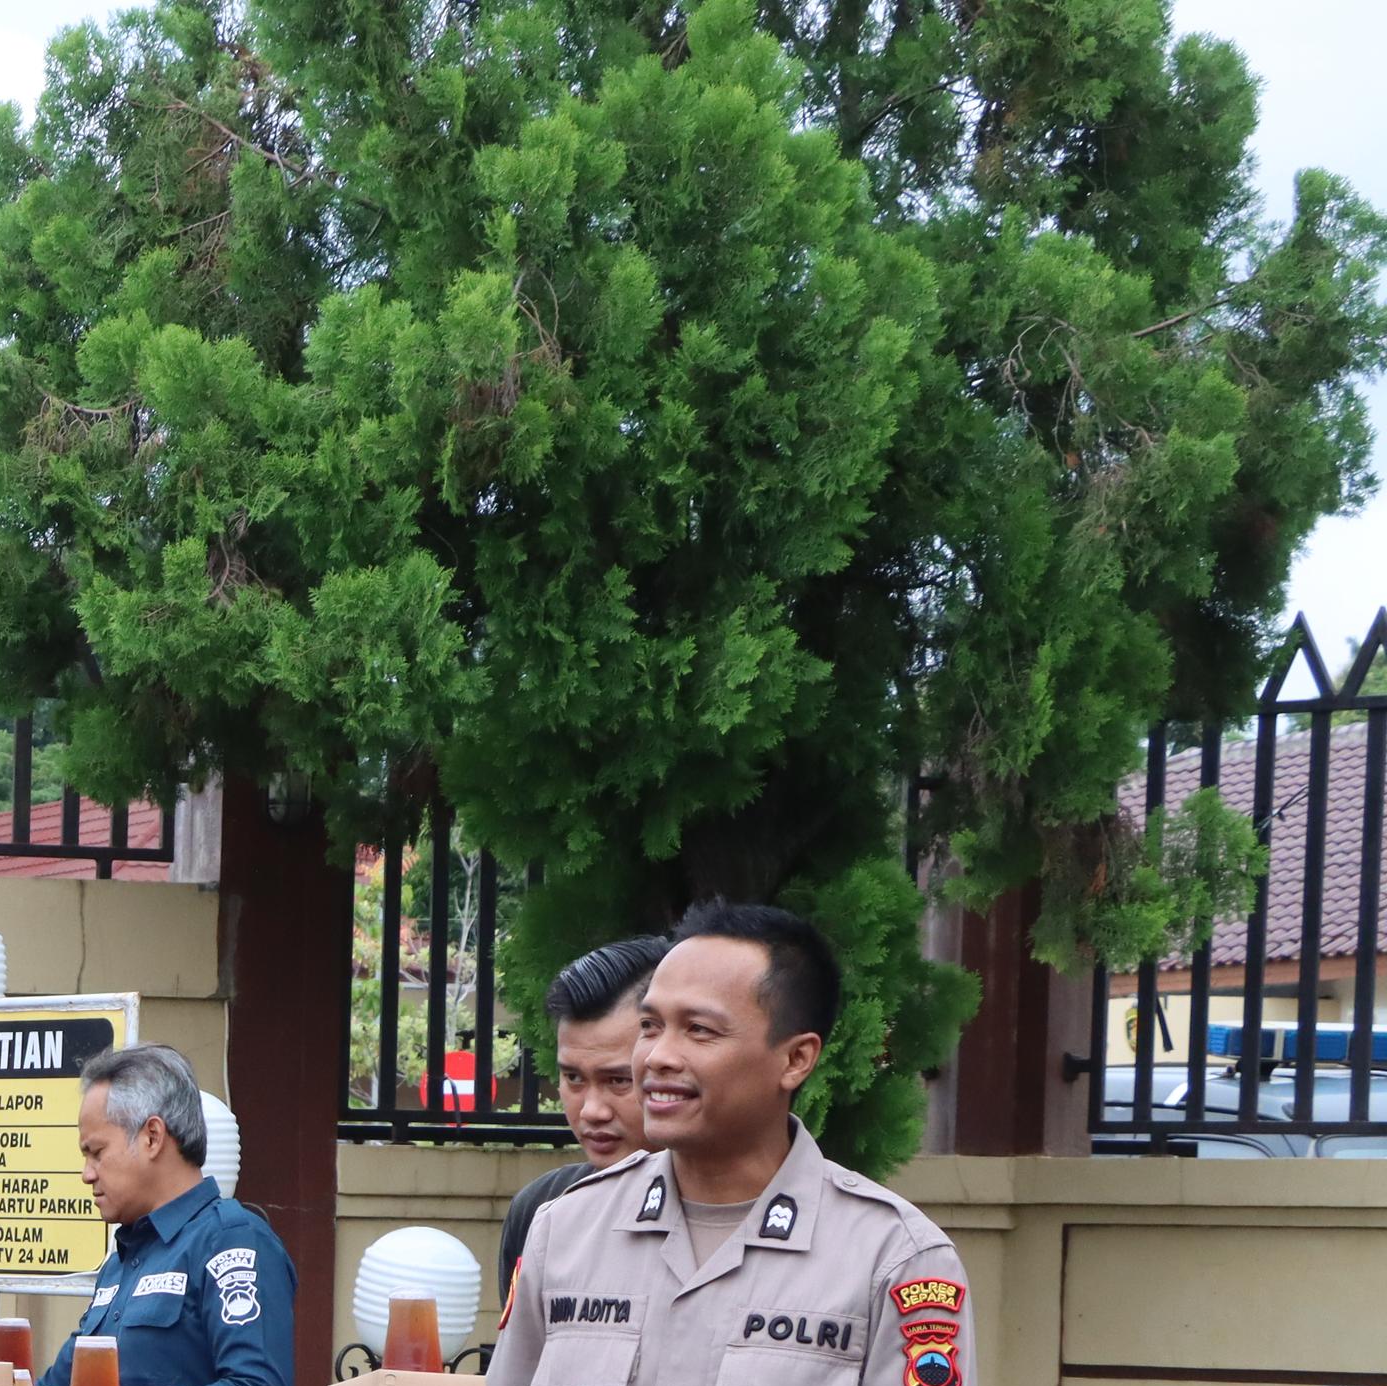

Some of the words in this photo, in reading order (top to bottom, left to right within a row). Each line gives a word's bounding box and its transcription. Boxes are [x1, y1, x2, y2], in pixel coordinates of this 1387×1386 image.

[1, 1178, 49, 1194] HARAP
[39, 1198, 92, 1215] PARKIR
[18, 1249, 34, 1264] 24
[38, 1249, 69, 1264] JAM
[900, 1281, 957, 1299] POLRES
[902, 1292, 956, 1308] JEPARA
[577, 1297, 631, 1323] ADITYA
[743, 1313, 852, 1351] POLRI
